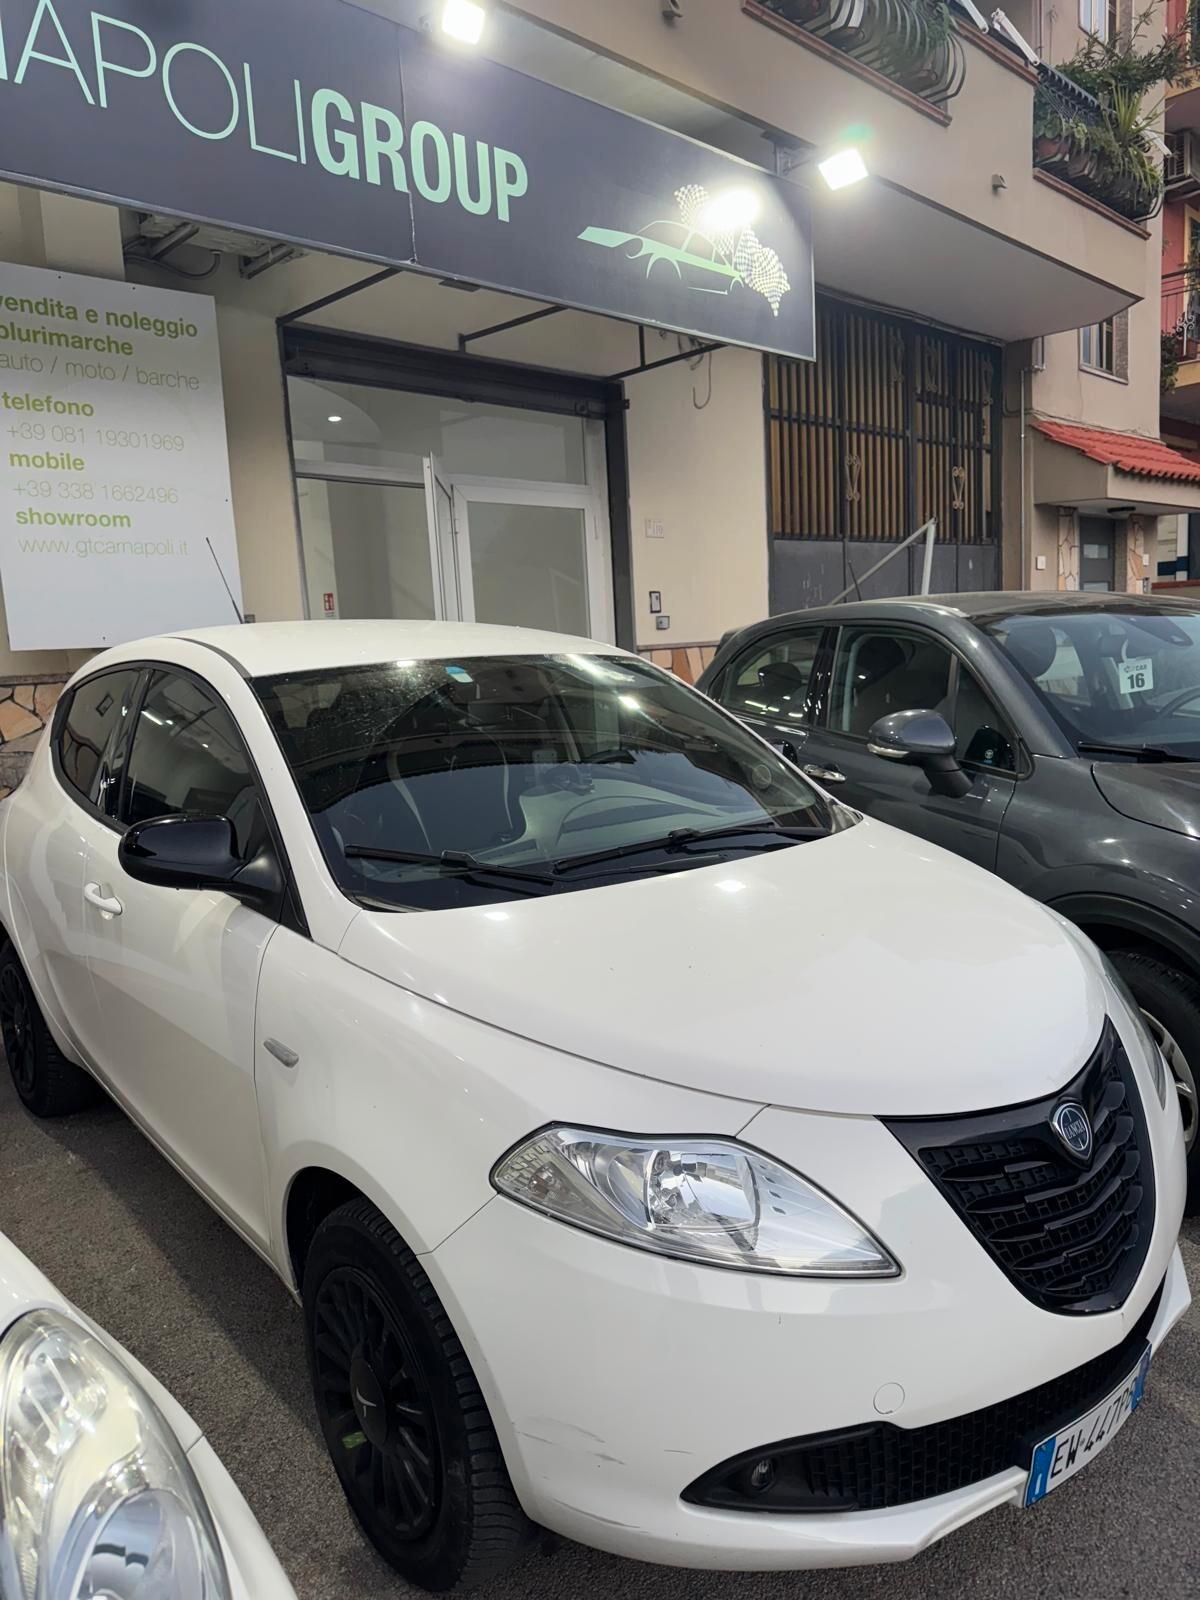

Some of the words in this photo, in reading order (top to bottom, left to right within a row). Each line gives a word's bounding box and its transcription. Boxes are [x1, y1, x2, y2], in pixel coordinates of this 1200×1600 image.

[0, 0, 528, 223] APOLIGROUP
[0, 295, 78, 322] endita
[85, 308, 99, 323] e
[105, 311, 198, 339] noleggio
[0, 353, 44, 373] auto
[65, 361, 116, 380] moto
[136, 366, 200, 391] barche
[2, 391, 95, 417] telefono
[6, 422, 46, 441] +39
[51, 424, 85, 444] 081
[96, 429, 184, 451] 19301969
[9, 451, 85, 471] mobile
[13, 479, 51, 498] +39
[58, 481, 94, 500] 338
[101, 484, 178, 504] 1662496
[15, 507, 132, 528] showroom
[1127, 672, 1146, 690] 16
